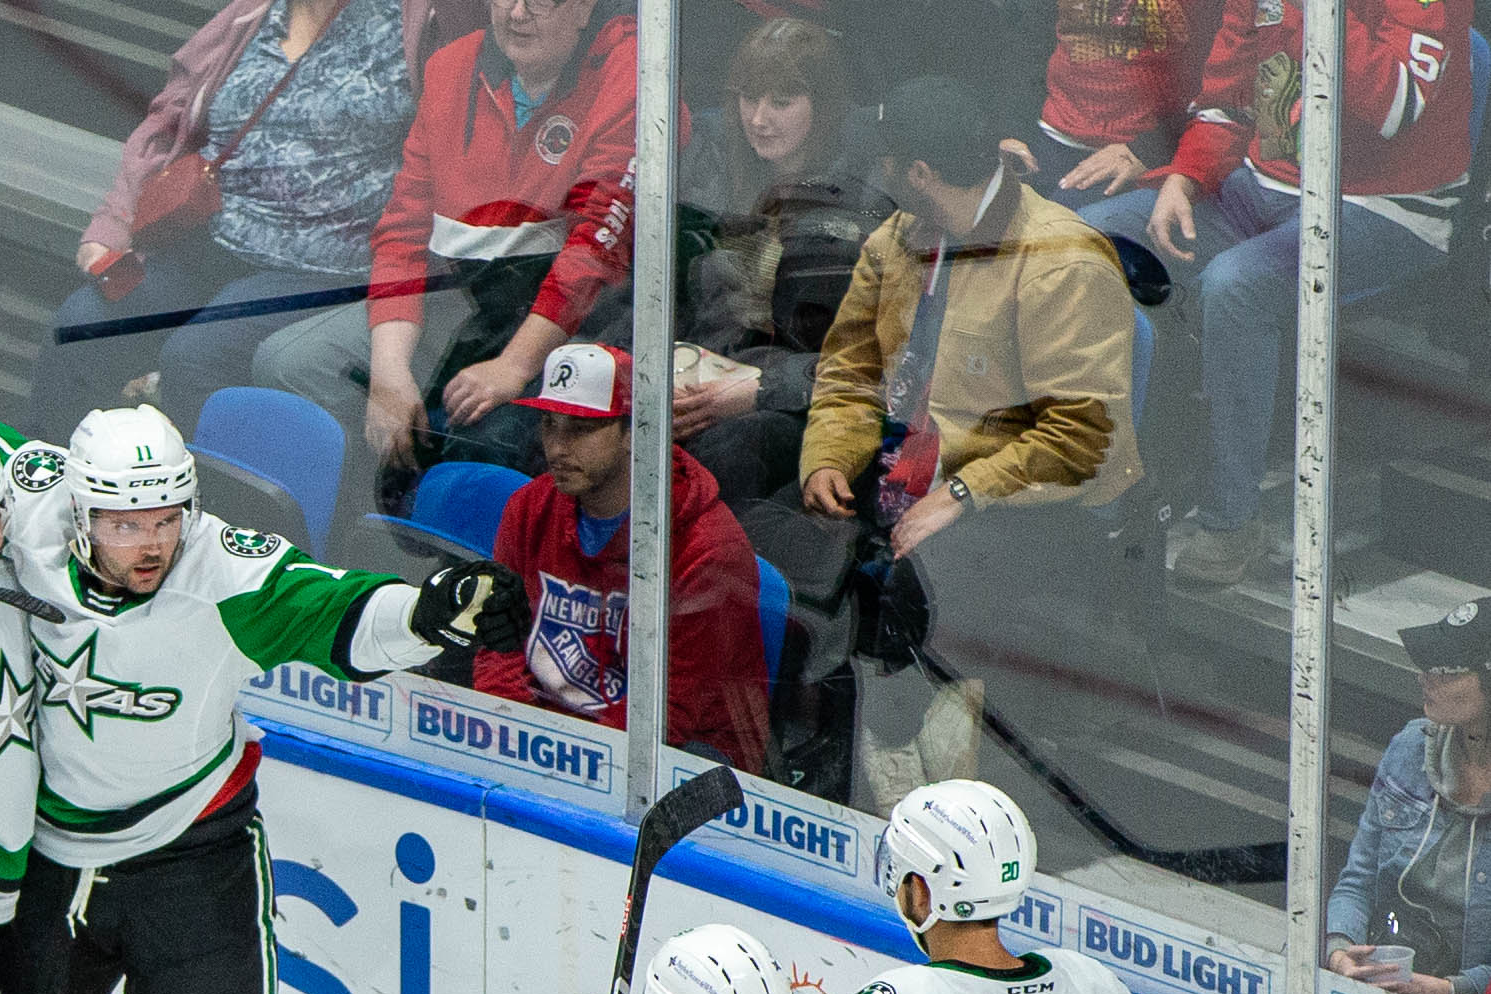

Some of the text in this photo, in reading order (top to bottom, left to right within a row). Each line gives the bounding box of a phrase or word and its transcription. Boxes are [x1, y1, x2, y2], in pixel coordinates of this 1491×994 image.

[136, 445, 153, 462] 11
[128, 477, 170, 489] CCM
[279, 663, 385, 721] LIGHT
[416, 701, 604, 782] BUD LIGHT
[753, 803, 851, 865] LIGHT
[1001, 860, 1020, 883] 20
[1084, 918, 1157, 968] BUD
